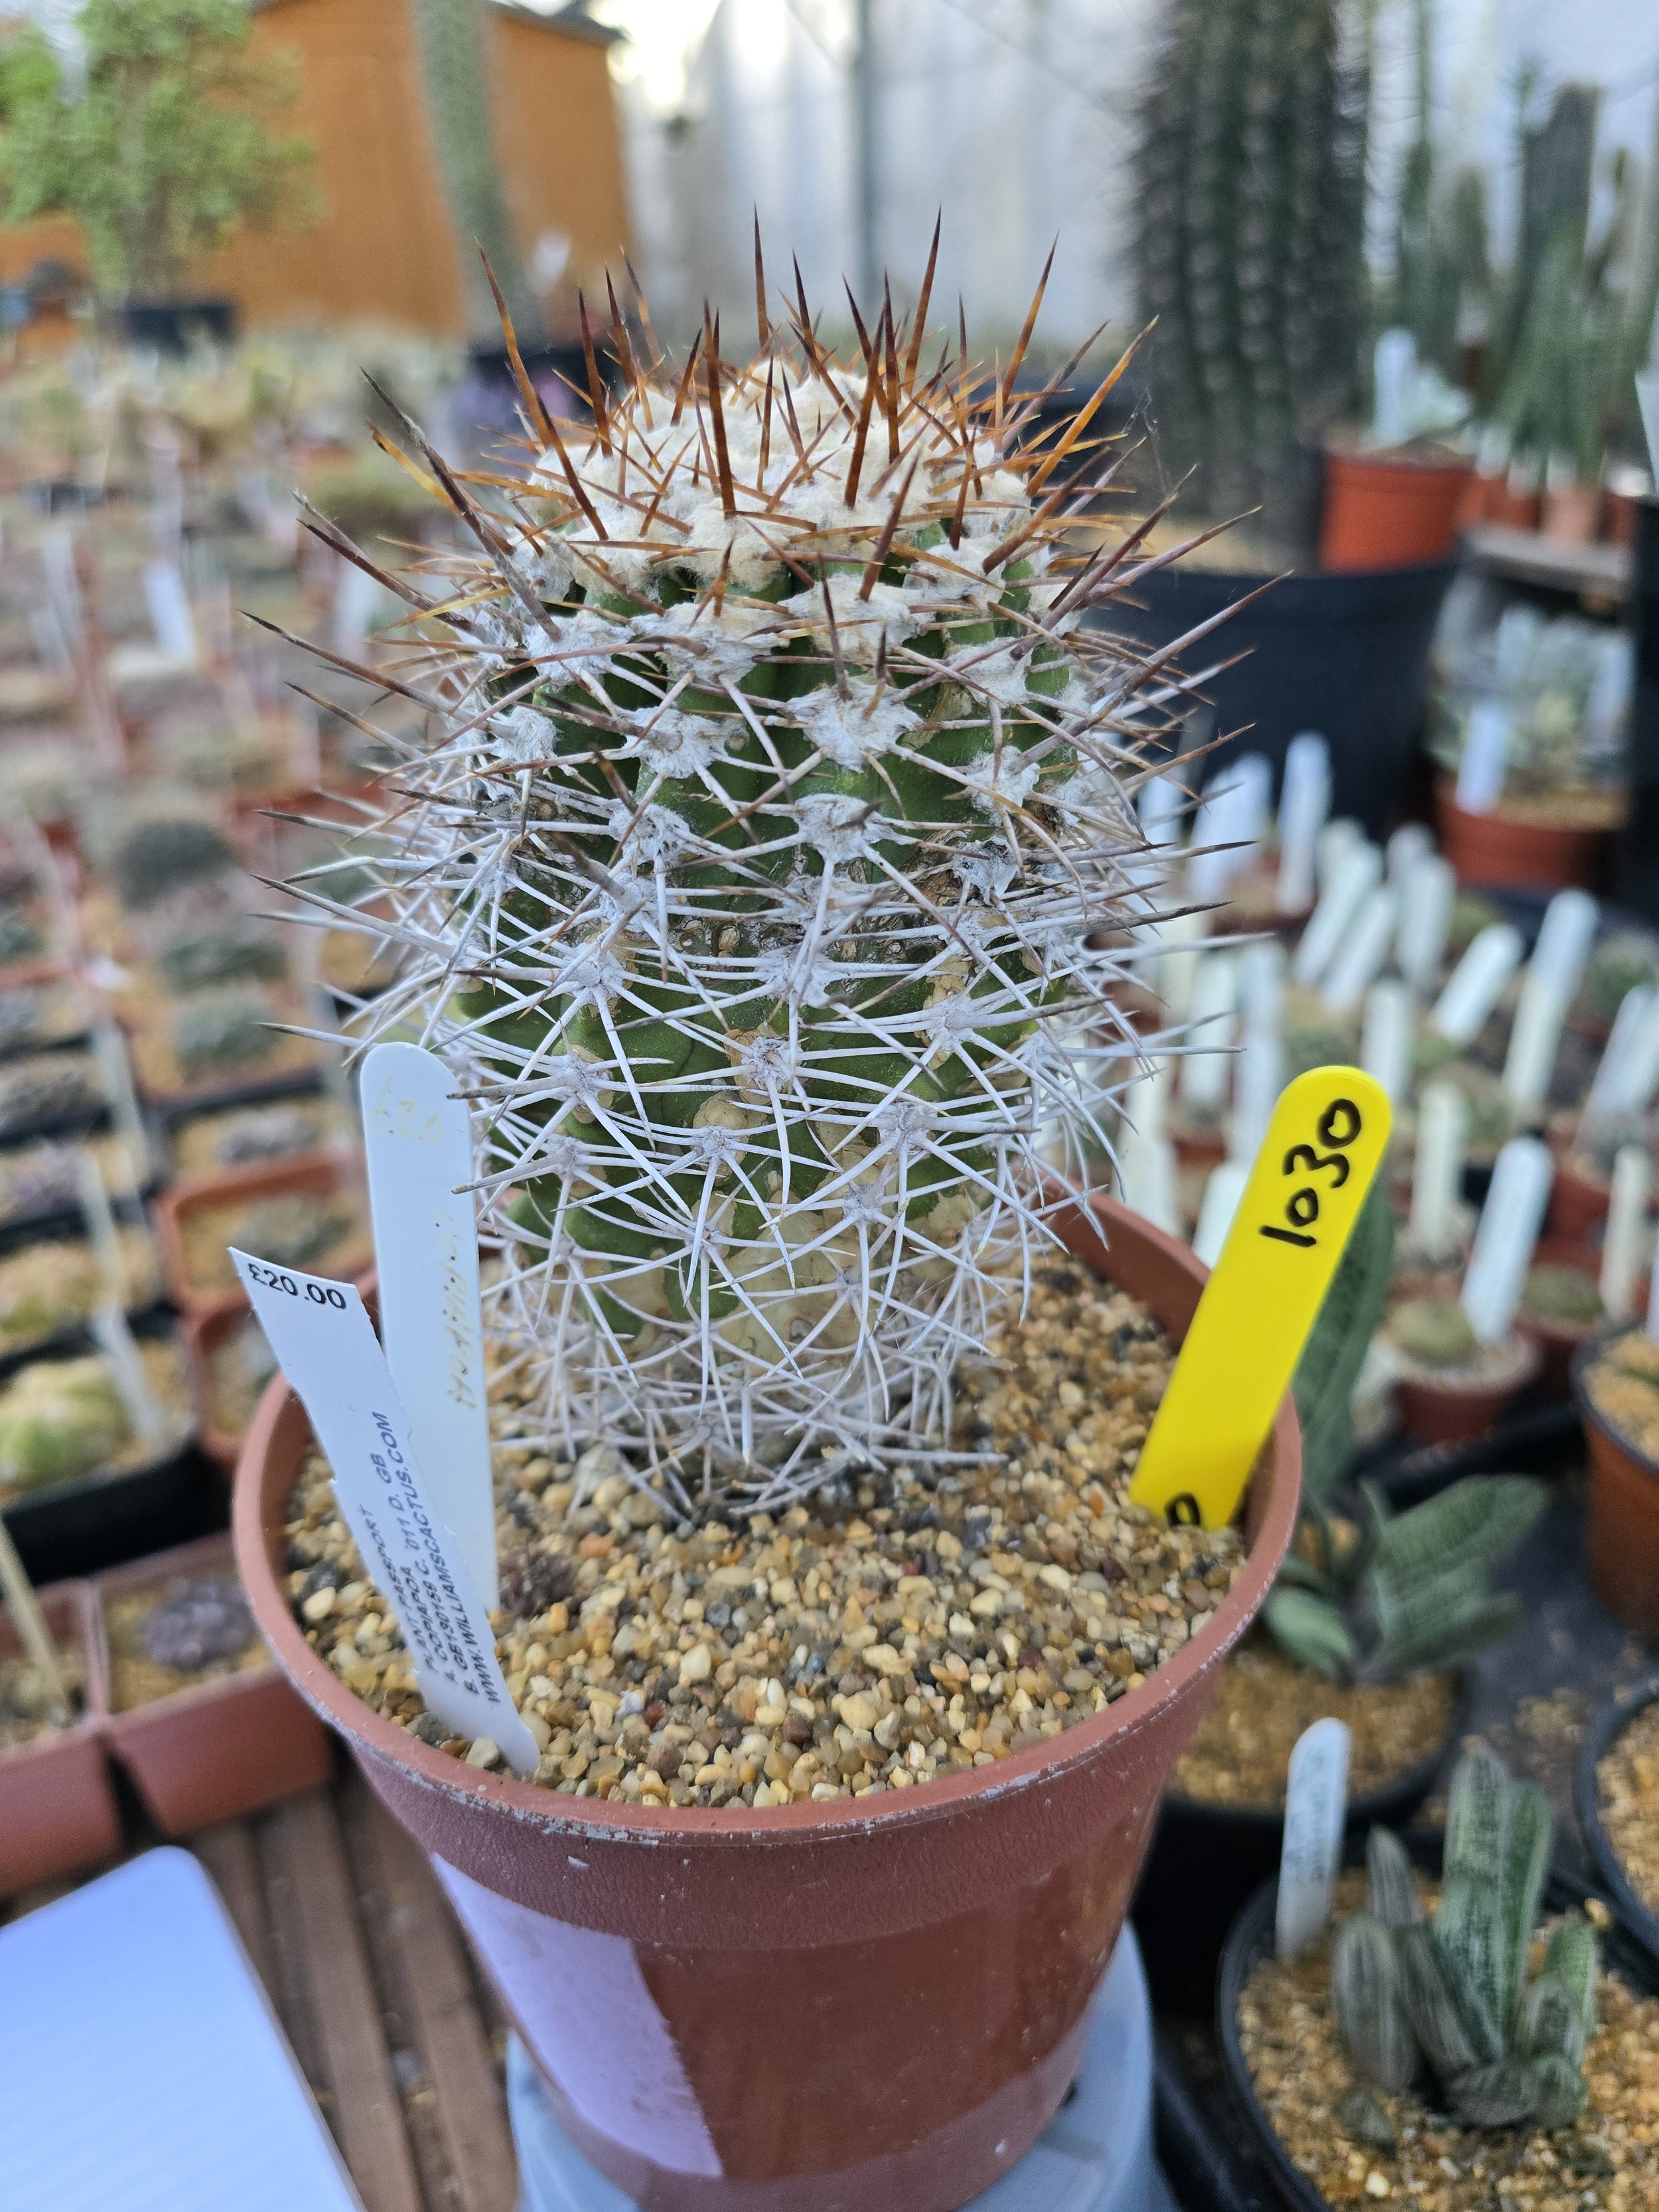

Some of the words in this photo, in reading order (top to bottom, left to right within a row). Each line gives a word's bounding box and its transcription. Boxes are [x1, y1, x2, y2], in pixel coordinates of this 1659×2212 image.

[1260, 1098, 1360, 1247] 1030
[248, 1262, 346, 1311] £20.00
[370, 1452, 392, 1484] GB
[388, 1494, 405, 1511] D.
[359, 1505, 412, 1609] PASSPORT
[372, 1411, 501, 1703] WWW.WILLIAMSCACTUS.COM
[415, 1559, 429, 1575] C.
[400, 1566, 448, 1660] COPIAPOA
[406, 1611, 439, 1672] PLANT
[445, 1670, 459, 1684] A.
[464, 1679, 479, 1694] B.
